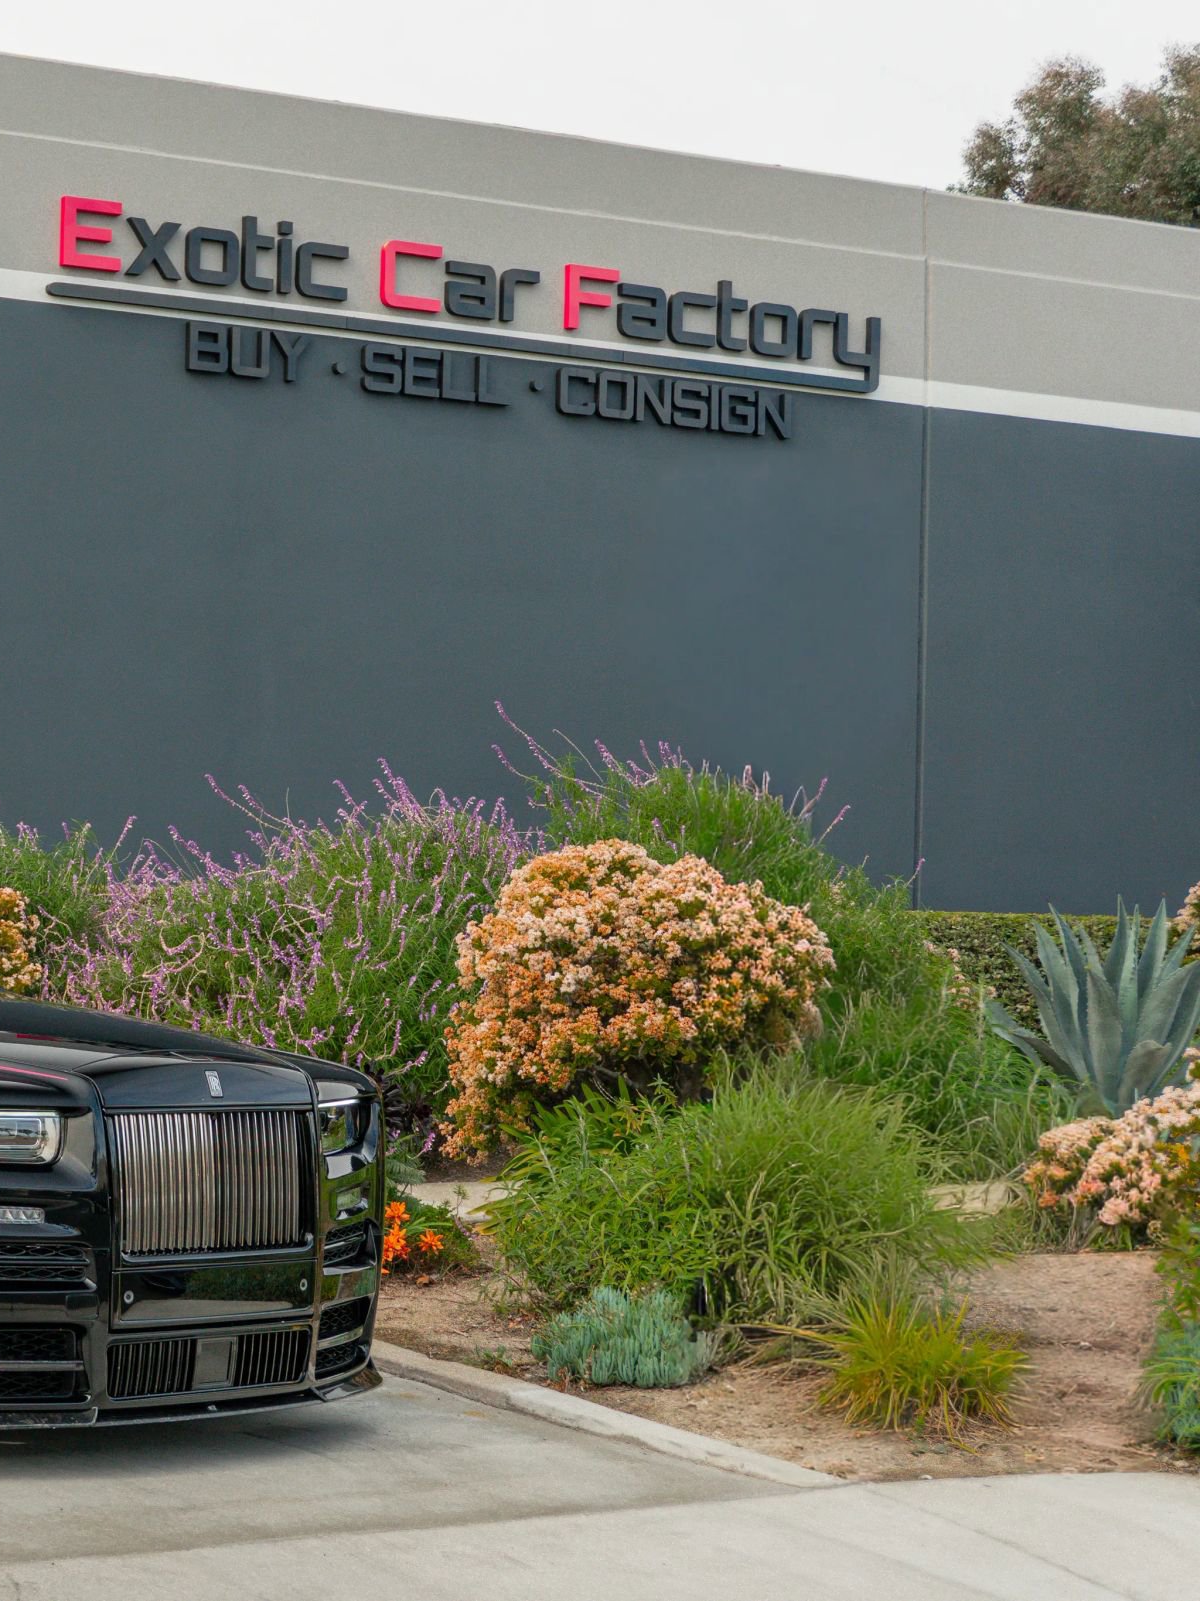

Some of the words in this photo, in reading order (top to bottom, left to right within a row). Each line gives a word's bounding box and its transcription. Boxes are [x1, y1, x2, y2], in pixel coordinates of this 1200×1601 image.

[59, 195, 350, 302] Exotic
[380, 240, 540, 322] Car
[563, 263, 882, 393] Factory
[185, 320, 309, 383] BUY
[360, 343, 510, 407] SELL
[555, 366, 792, 440] CONSIGN
